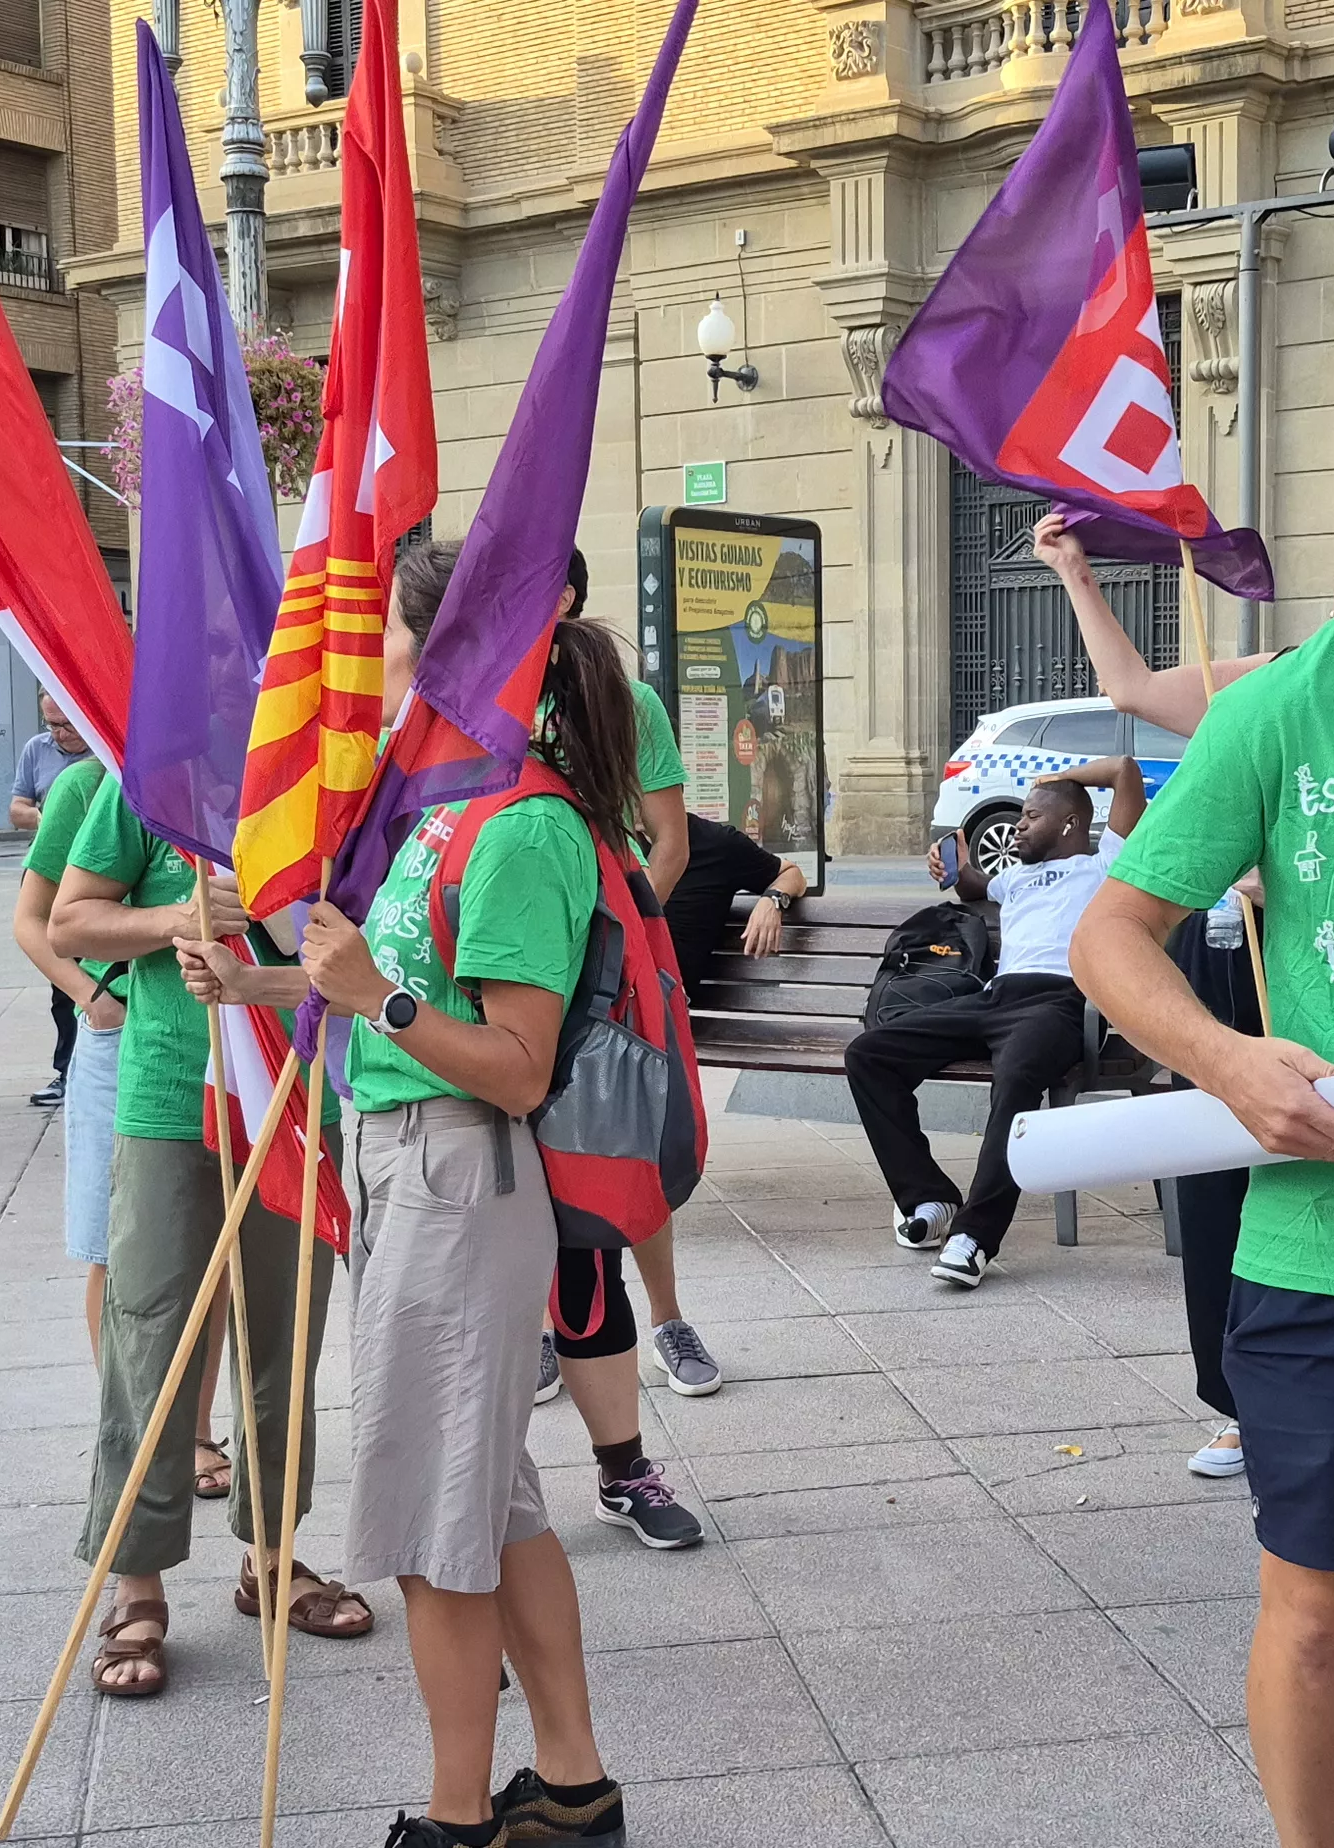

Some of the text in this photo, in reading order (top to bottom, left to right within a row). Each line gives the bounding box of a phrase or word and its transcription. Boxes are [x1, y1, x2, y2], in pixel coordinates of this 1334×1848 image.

[735, 518, 761, 527] URBAN
[678, 540, 763, 567] VISITAS GUIADAS
[678, 567, 752, 592] Y ECOTURISMO
